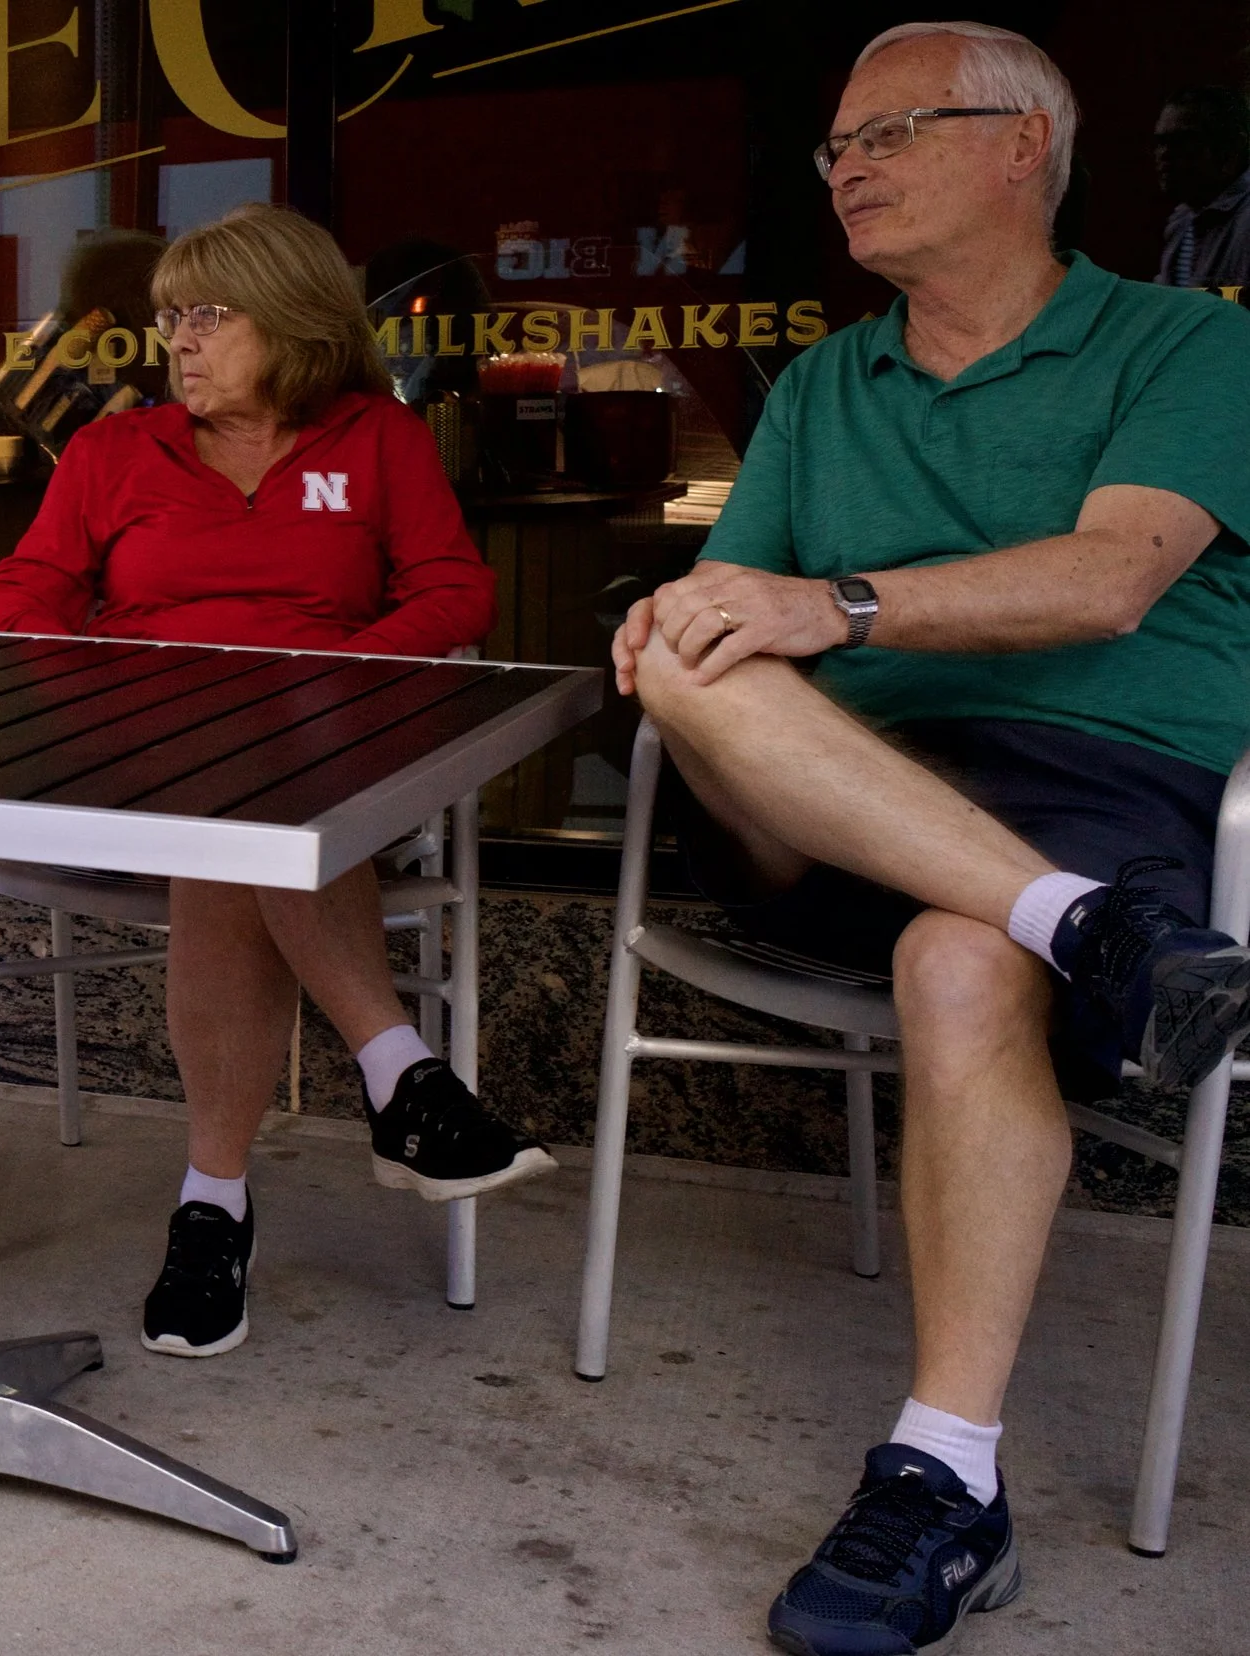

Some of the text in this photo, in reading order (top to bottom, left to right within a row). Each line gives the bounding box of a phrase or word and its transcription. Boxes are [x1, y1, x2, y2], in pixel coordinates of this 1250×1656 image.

[60, 326, 171, 369] CON
[368, 300, 829, 358] MILKSHAKES
[302, 471, 348, 512] N
[941, 1551, 977, 1589] FILA
